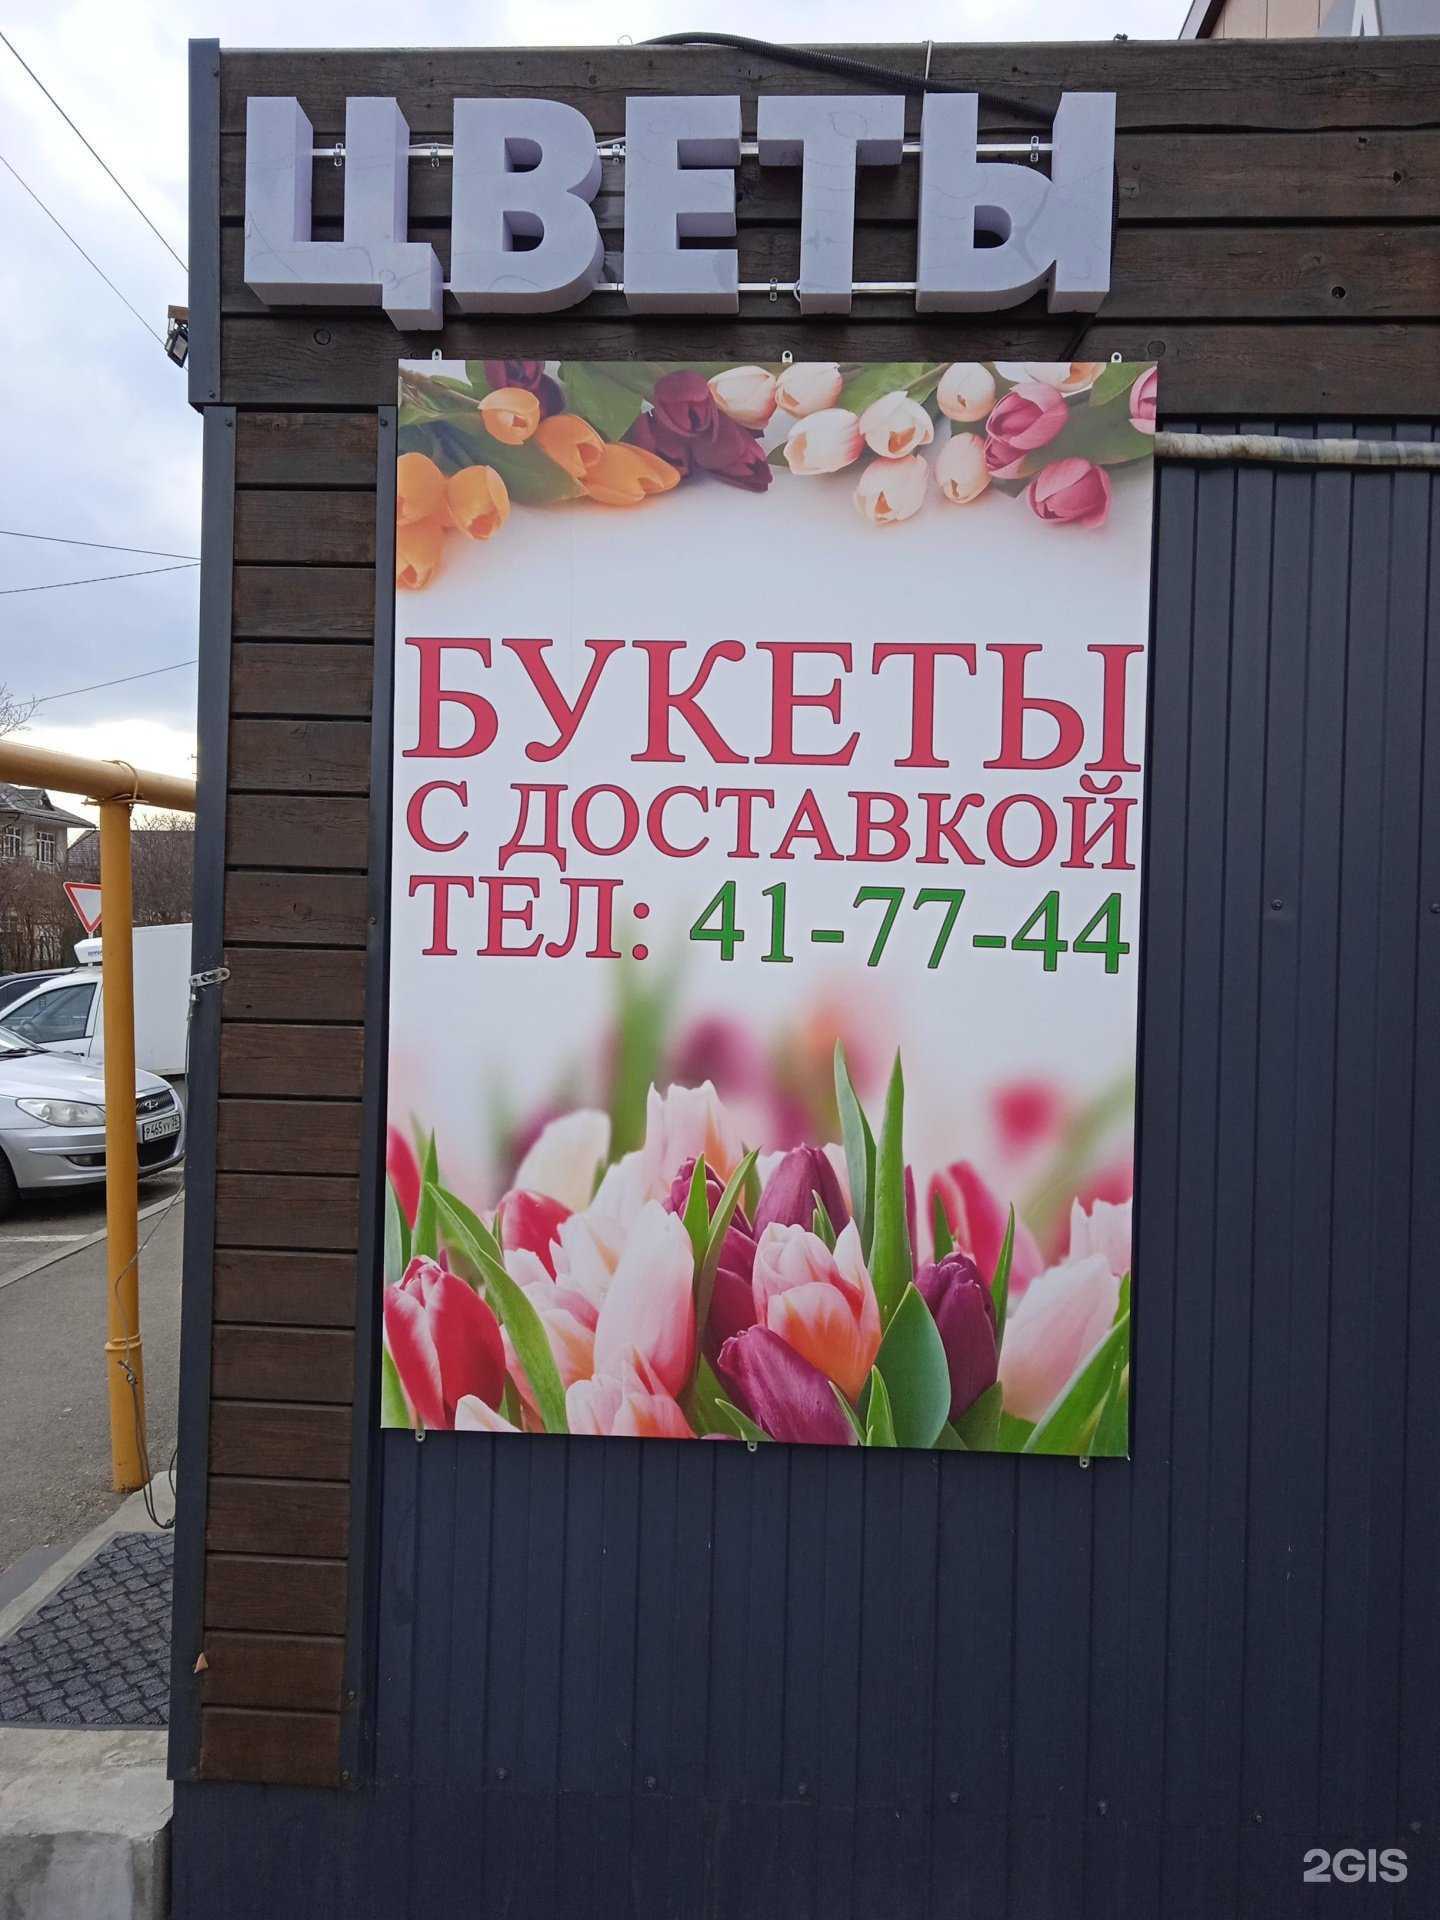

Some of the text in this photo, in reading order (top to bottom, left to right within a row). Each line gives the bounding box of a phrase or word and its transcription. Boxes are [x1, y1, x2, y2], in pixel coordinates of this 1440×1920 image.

[243, 91, 1117, 332] ЦВЕТЫ
[401, 636, 1145, 773] БУКЕТЫ
[405, 774, 1139, 872] С ДОСТАВКОЙ
[407, 874, 1131, 975] ТЕЛ: 41-77-44
